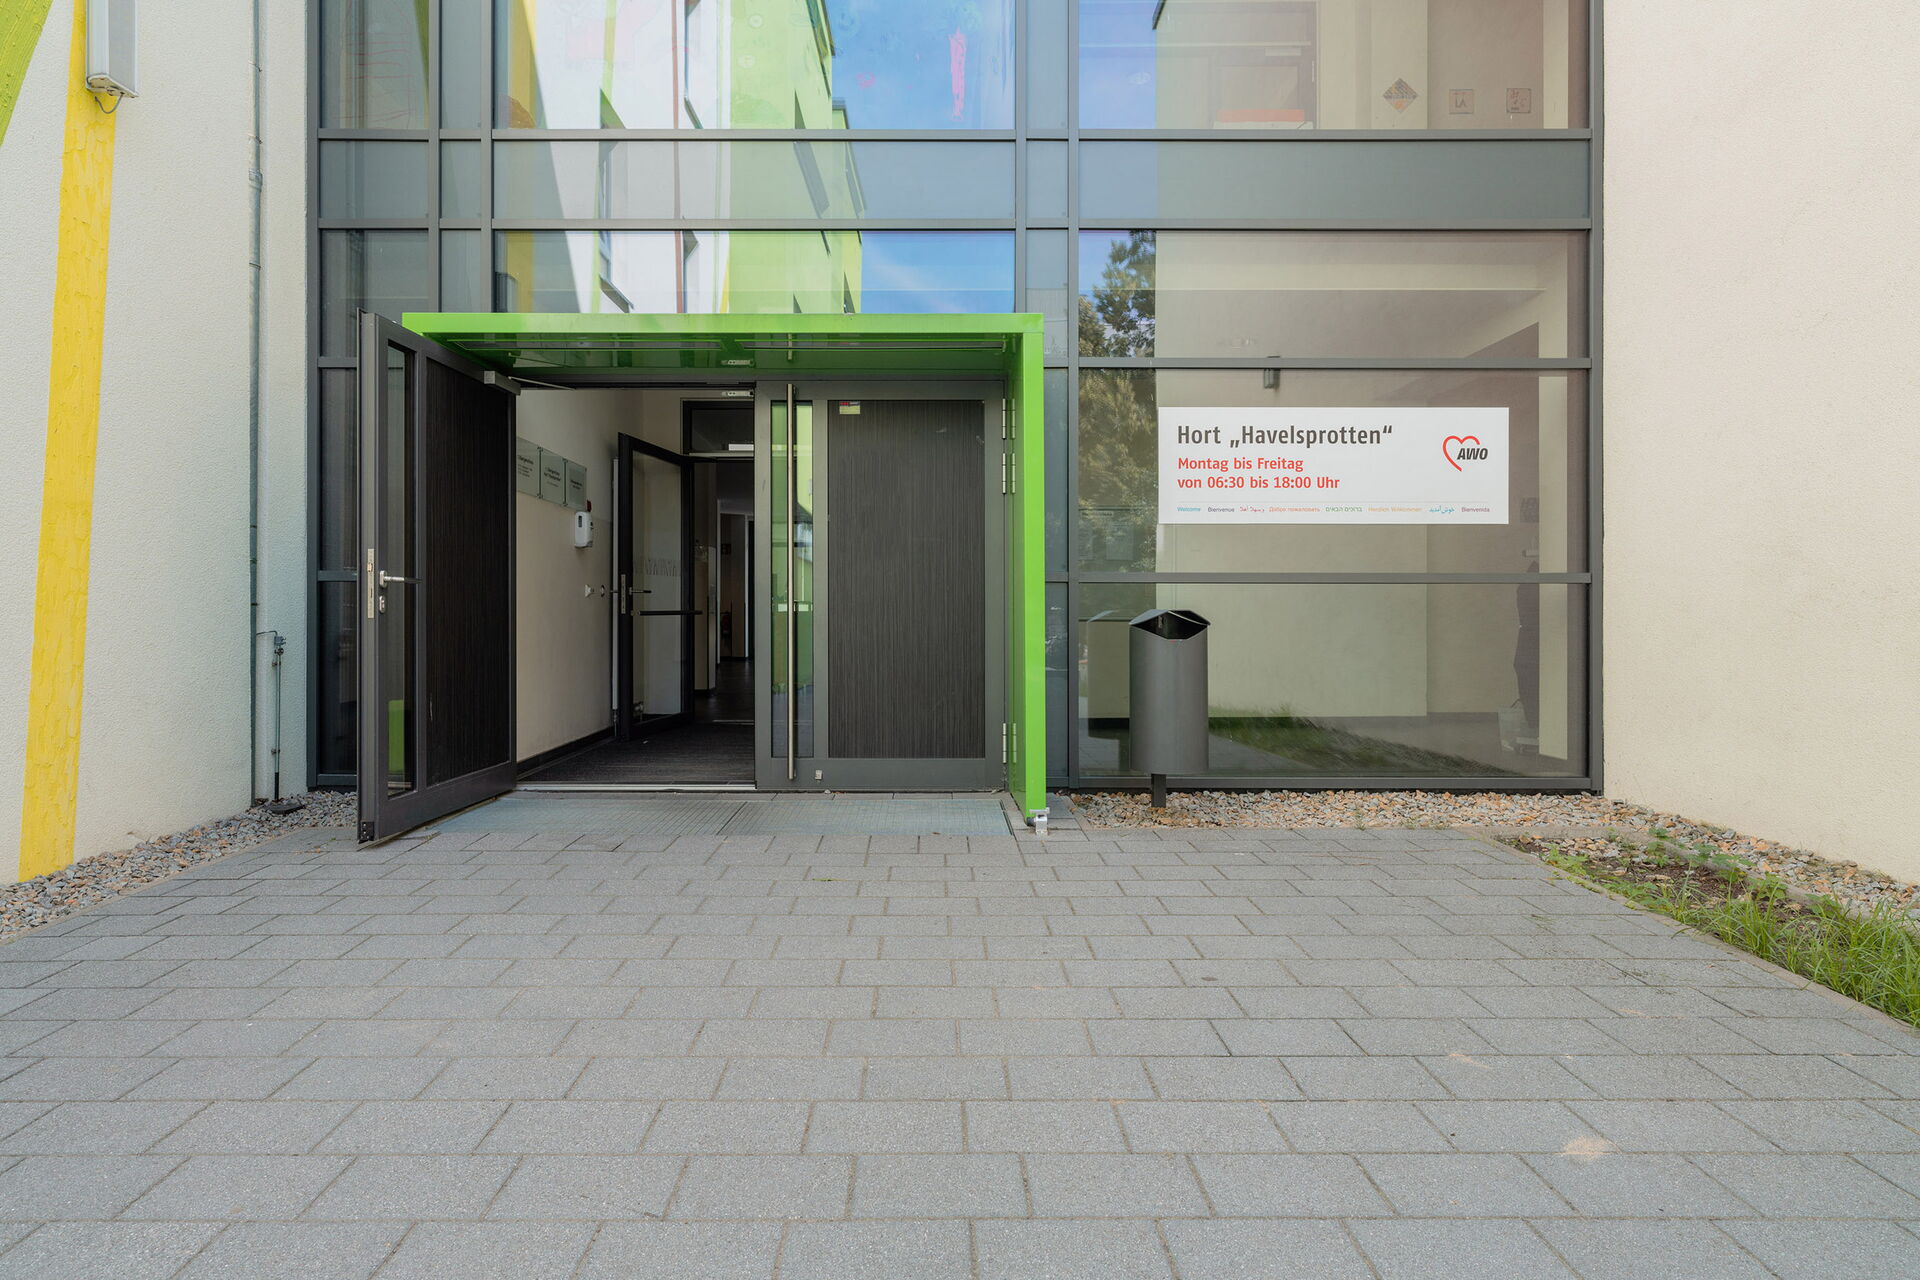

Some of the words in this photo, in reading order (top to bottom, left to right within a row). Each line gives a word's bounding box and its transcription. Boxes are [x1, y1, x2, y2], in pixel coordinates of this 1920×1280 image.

[1177, 425, 1222, 444] Hort
[1229, 425, 1393, 449] „Havelsprotten“
[1456, 447, 1489, 461] AWO
[1178, 457, 1229, 472] Montag
[1233, 456, 1253, 470] bis
[1257, 456, 1304, 472] Freitag
[1177, 478, 1202, 489] von
[1207, 476, 1245, 489] 06:30
[1249, 475, 1269, 489] bis
[1273, 476, 1312, 489] 18:00
[1316, 476, 1341, 489] Uhr
